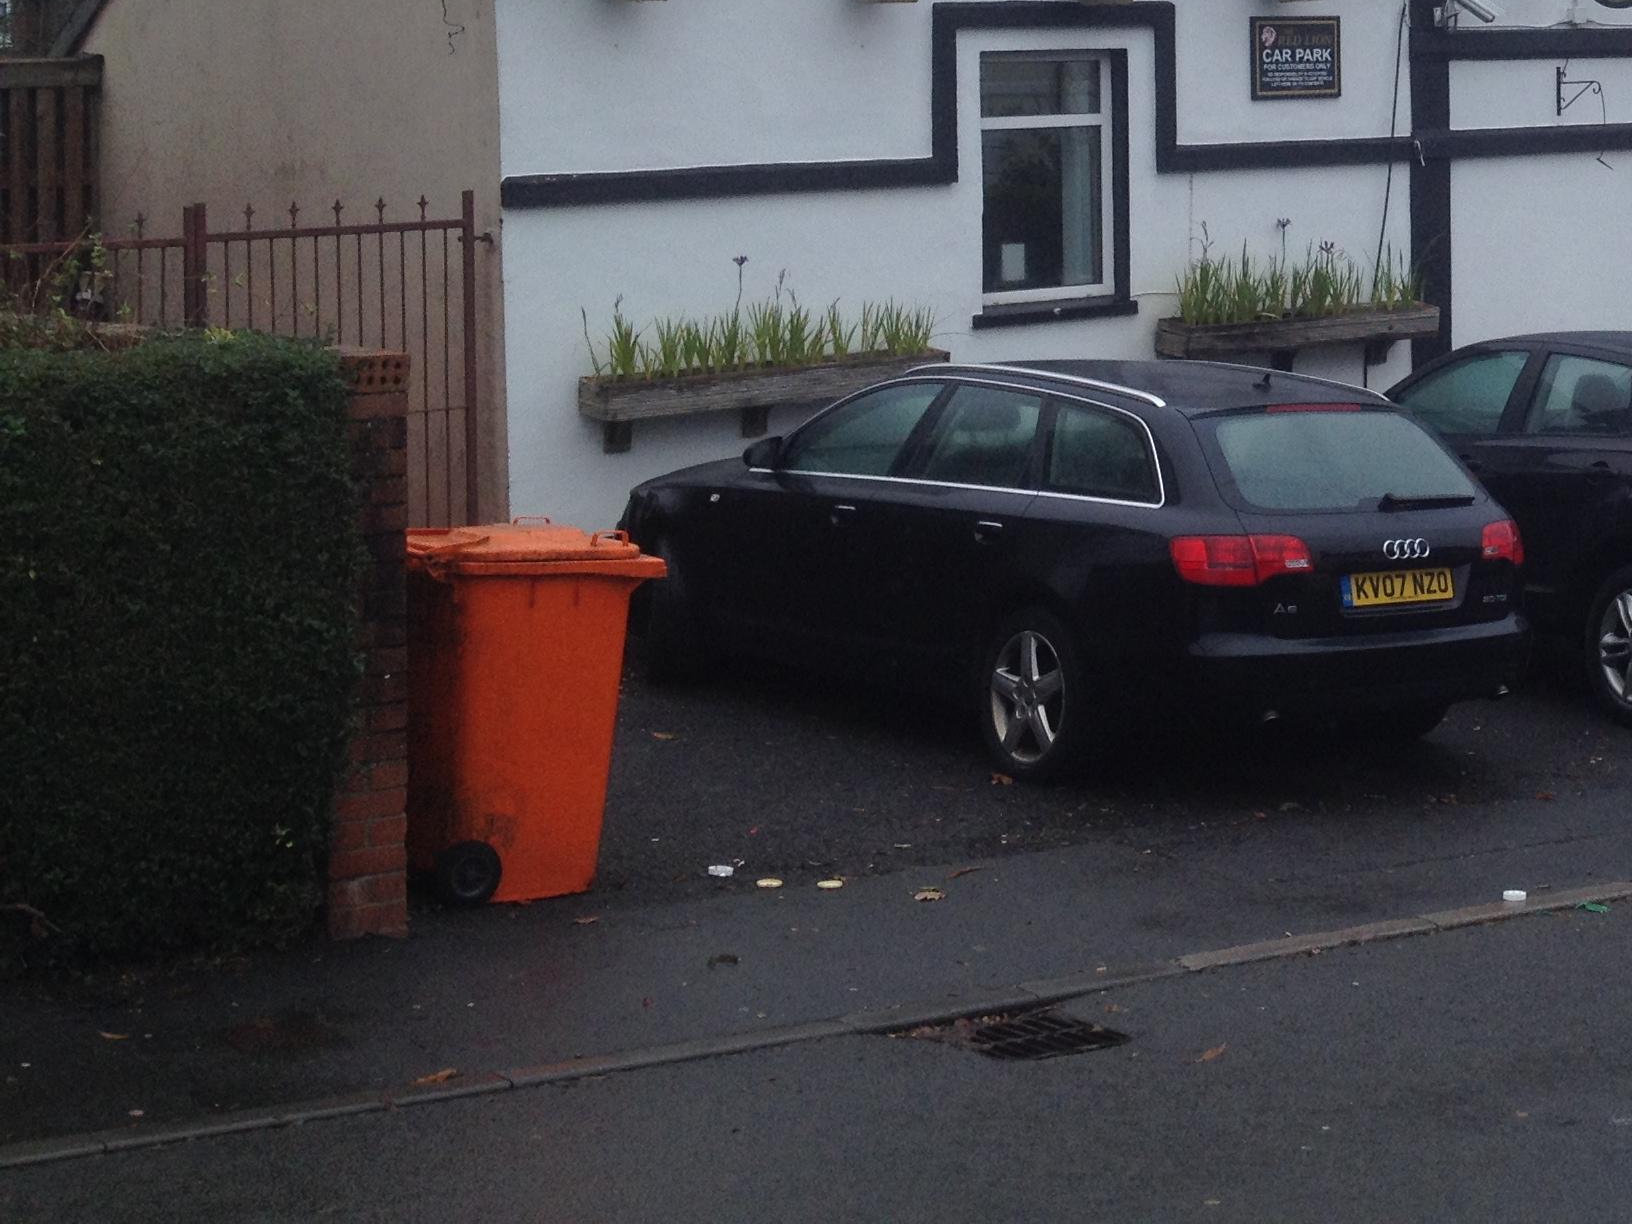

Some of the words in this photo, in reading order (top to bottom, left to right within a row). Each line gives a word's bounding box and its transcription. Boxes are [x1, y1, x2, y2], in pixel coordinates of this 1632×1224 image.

[1262, 49, 1291, 62] CAR
[1295, 49, 1331, 61] PARK
[1354, 574, 1406, 600] KV07
[1413, 572, 1449, 596] NZO
[1273, 602, 1298, 615] A6
